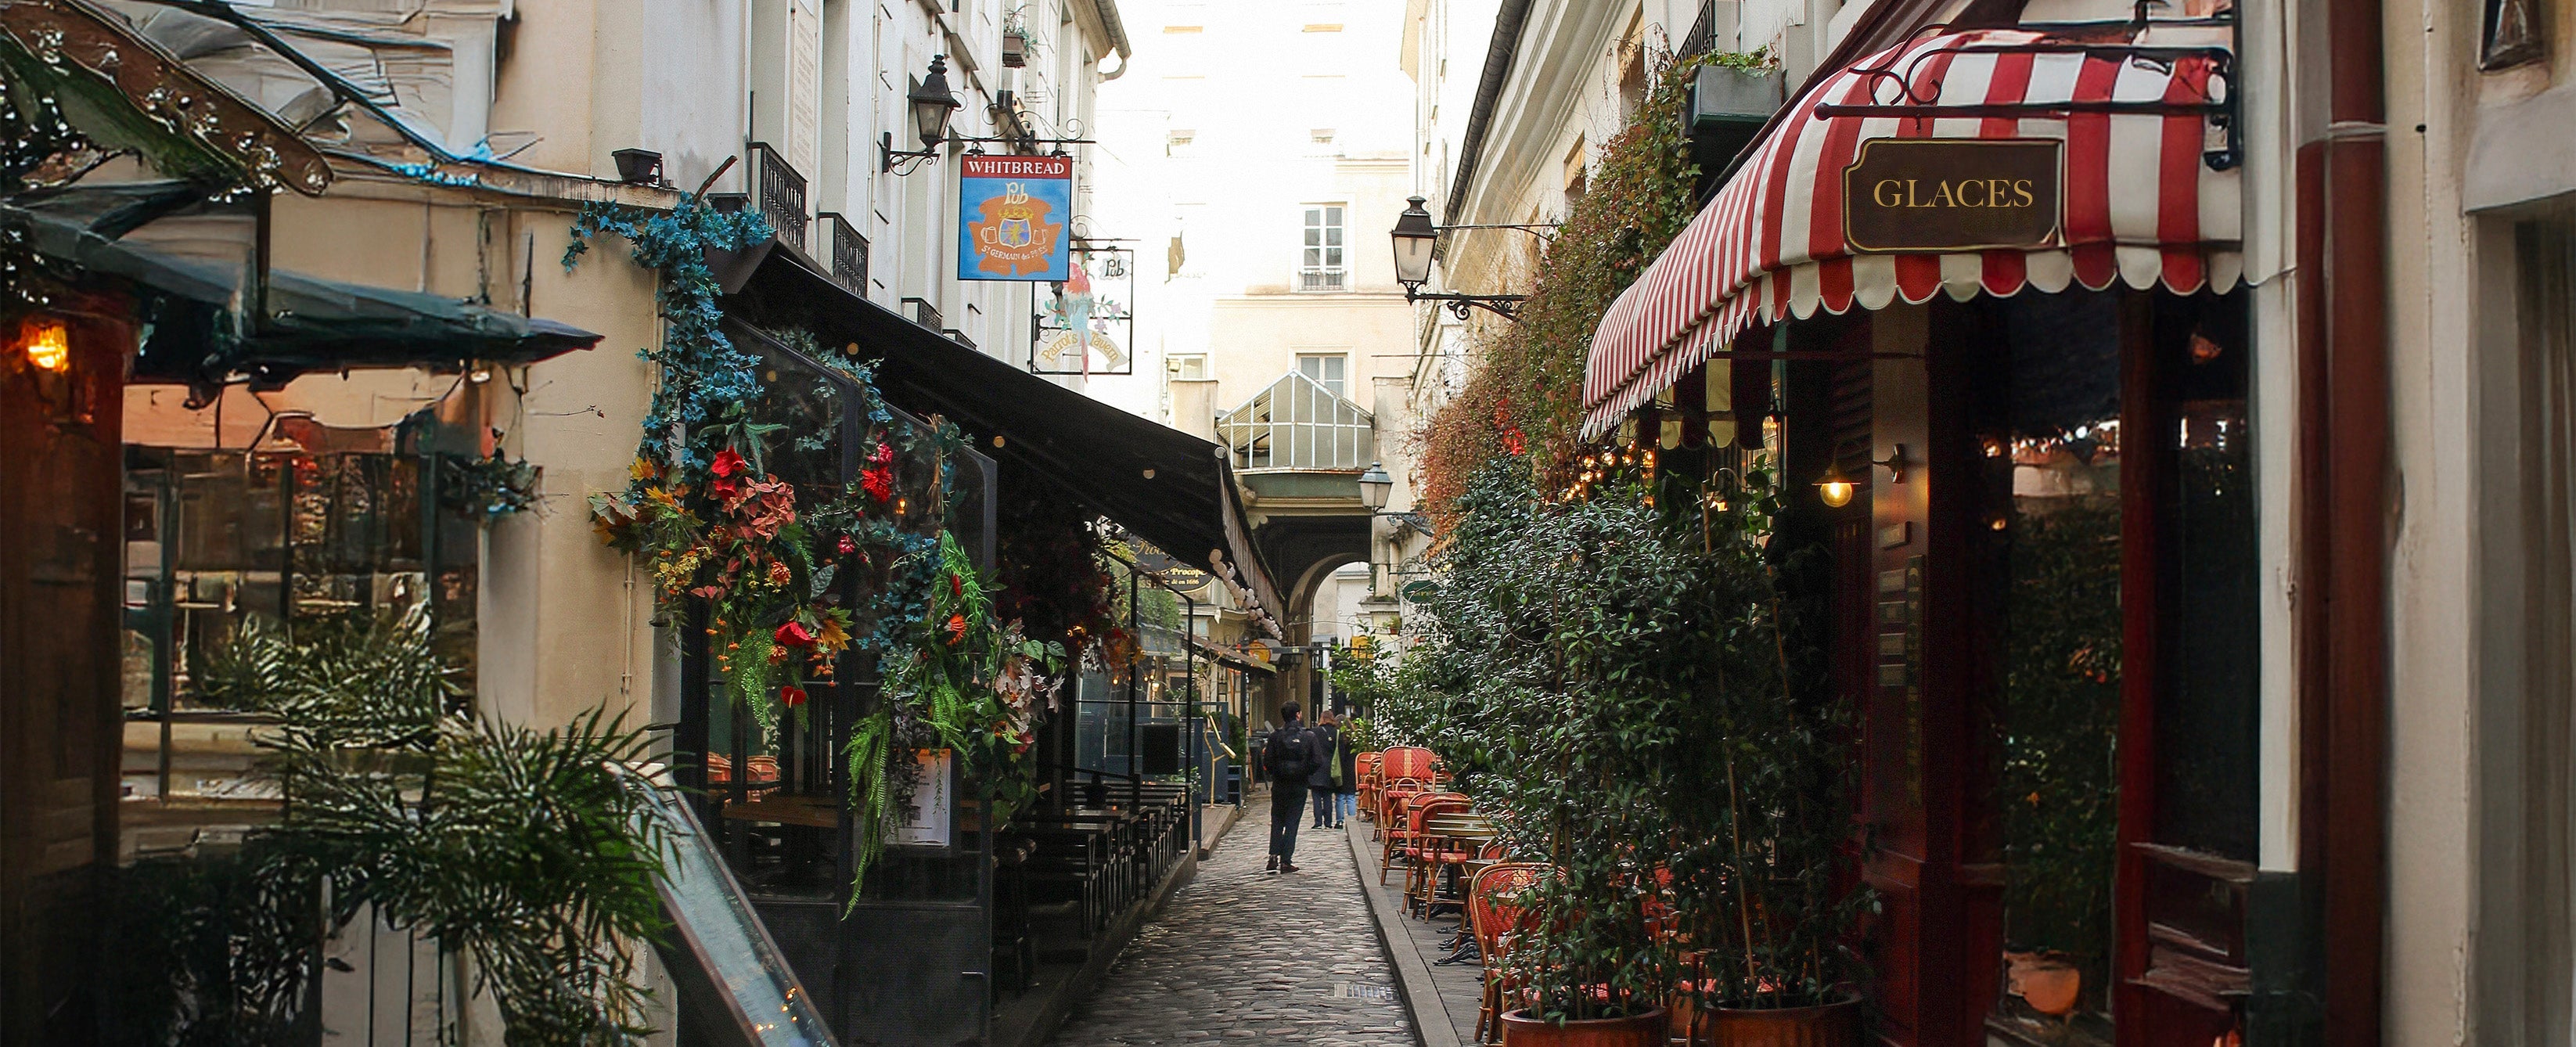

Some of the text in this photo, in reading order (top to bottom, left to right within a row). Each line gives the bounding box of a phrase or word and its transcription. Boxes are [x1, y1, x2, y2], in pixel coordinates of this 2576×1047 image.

[968, 161, 1065, 174] WHITBREAD
[1004, 182, 1029, 206] Pub
[1873, 179, 2034, 207] GLACES
[990, 249, 1020, 261] GERMAIN
[1105, 259, 1124, 277] Pub
[1089, 332, 1119, 363] Tavern
